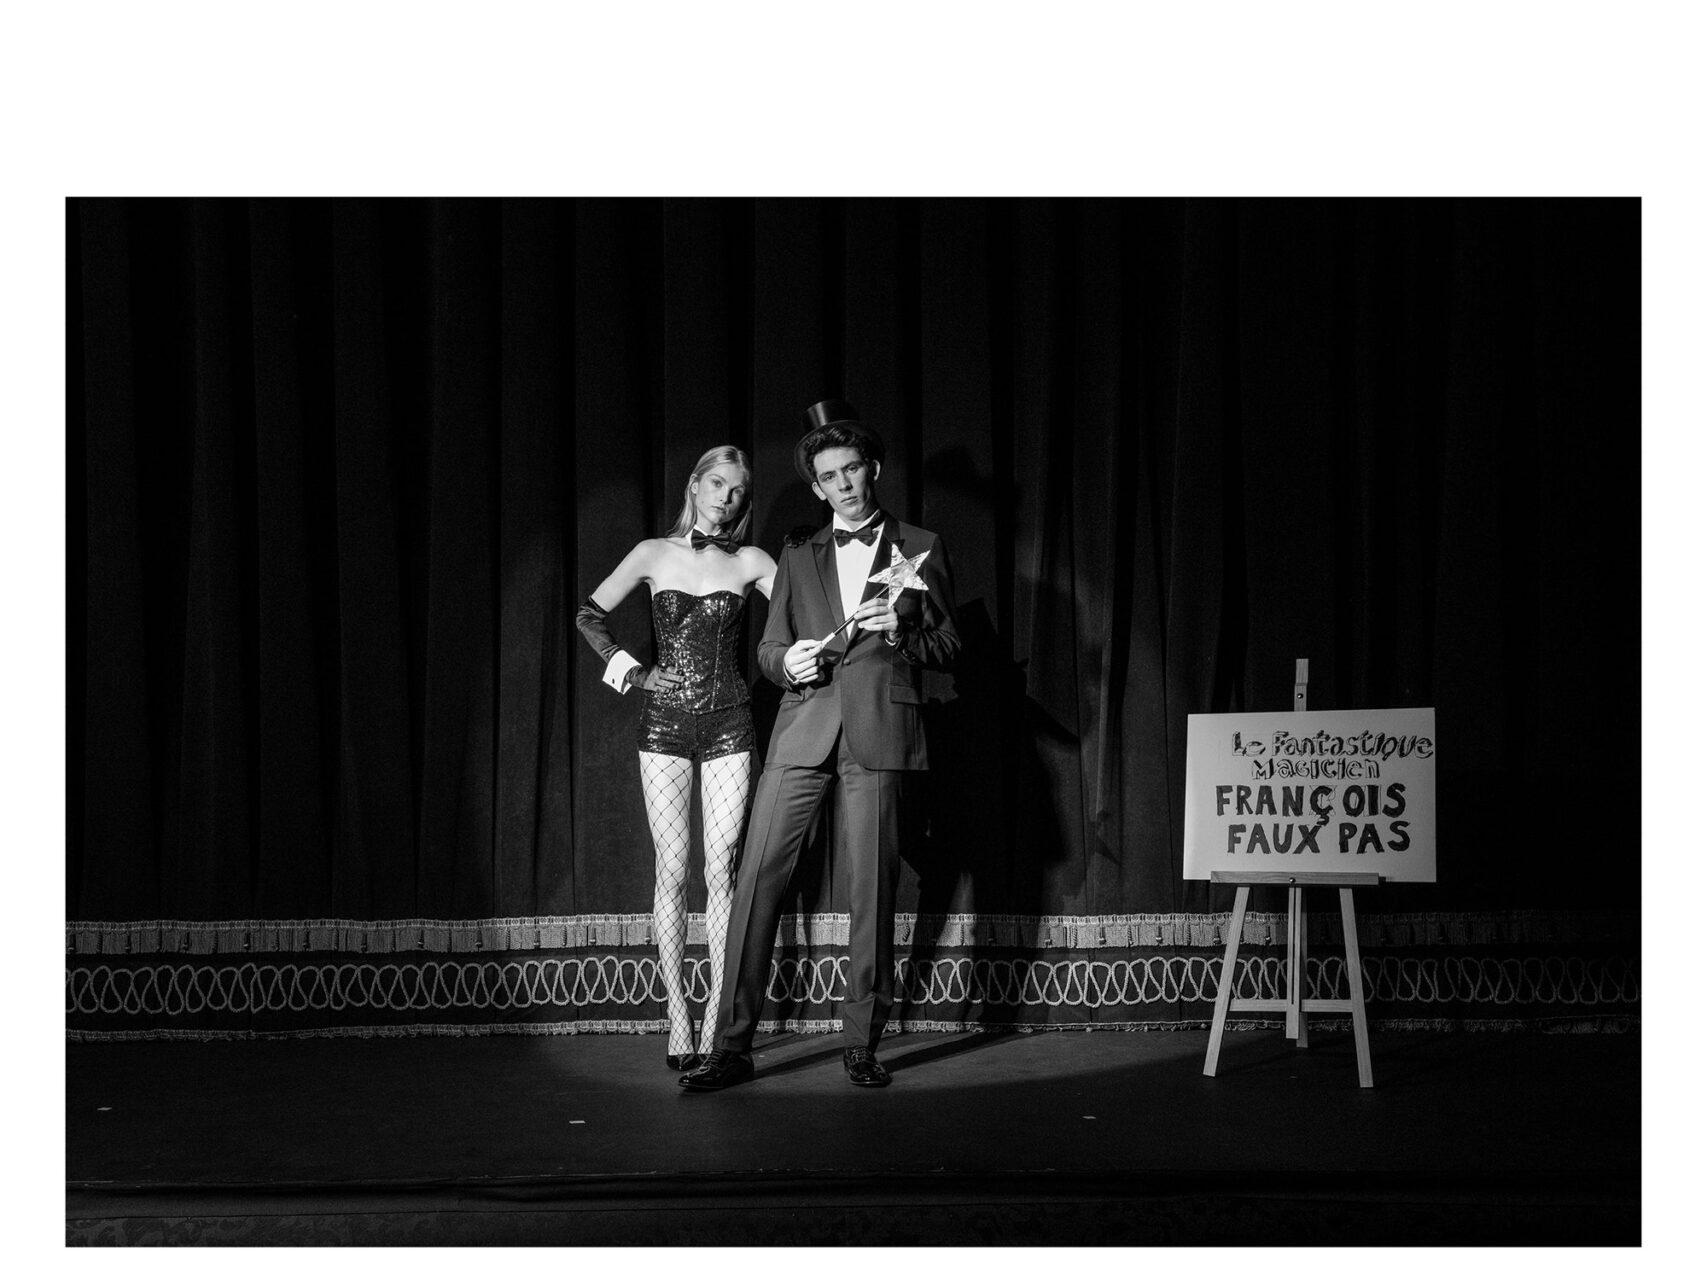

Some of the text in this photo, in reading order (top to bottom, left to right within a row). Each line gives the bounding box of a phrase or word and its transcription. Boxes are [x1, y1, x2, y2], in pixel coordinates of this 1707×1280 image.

[1232, 731, 1266, 756] Le
[1216, 782, 1407, 826] FRANÇOIS
[1227, 820, 1411, 854] FAUX PAS
